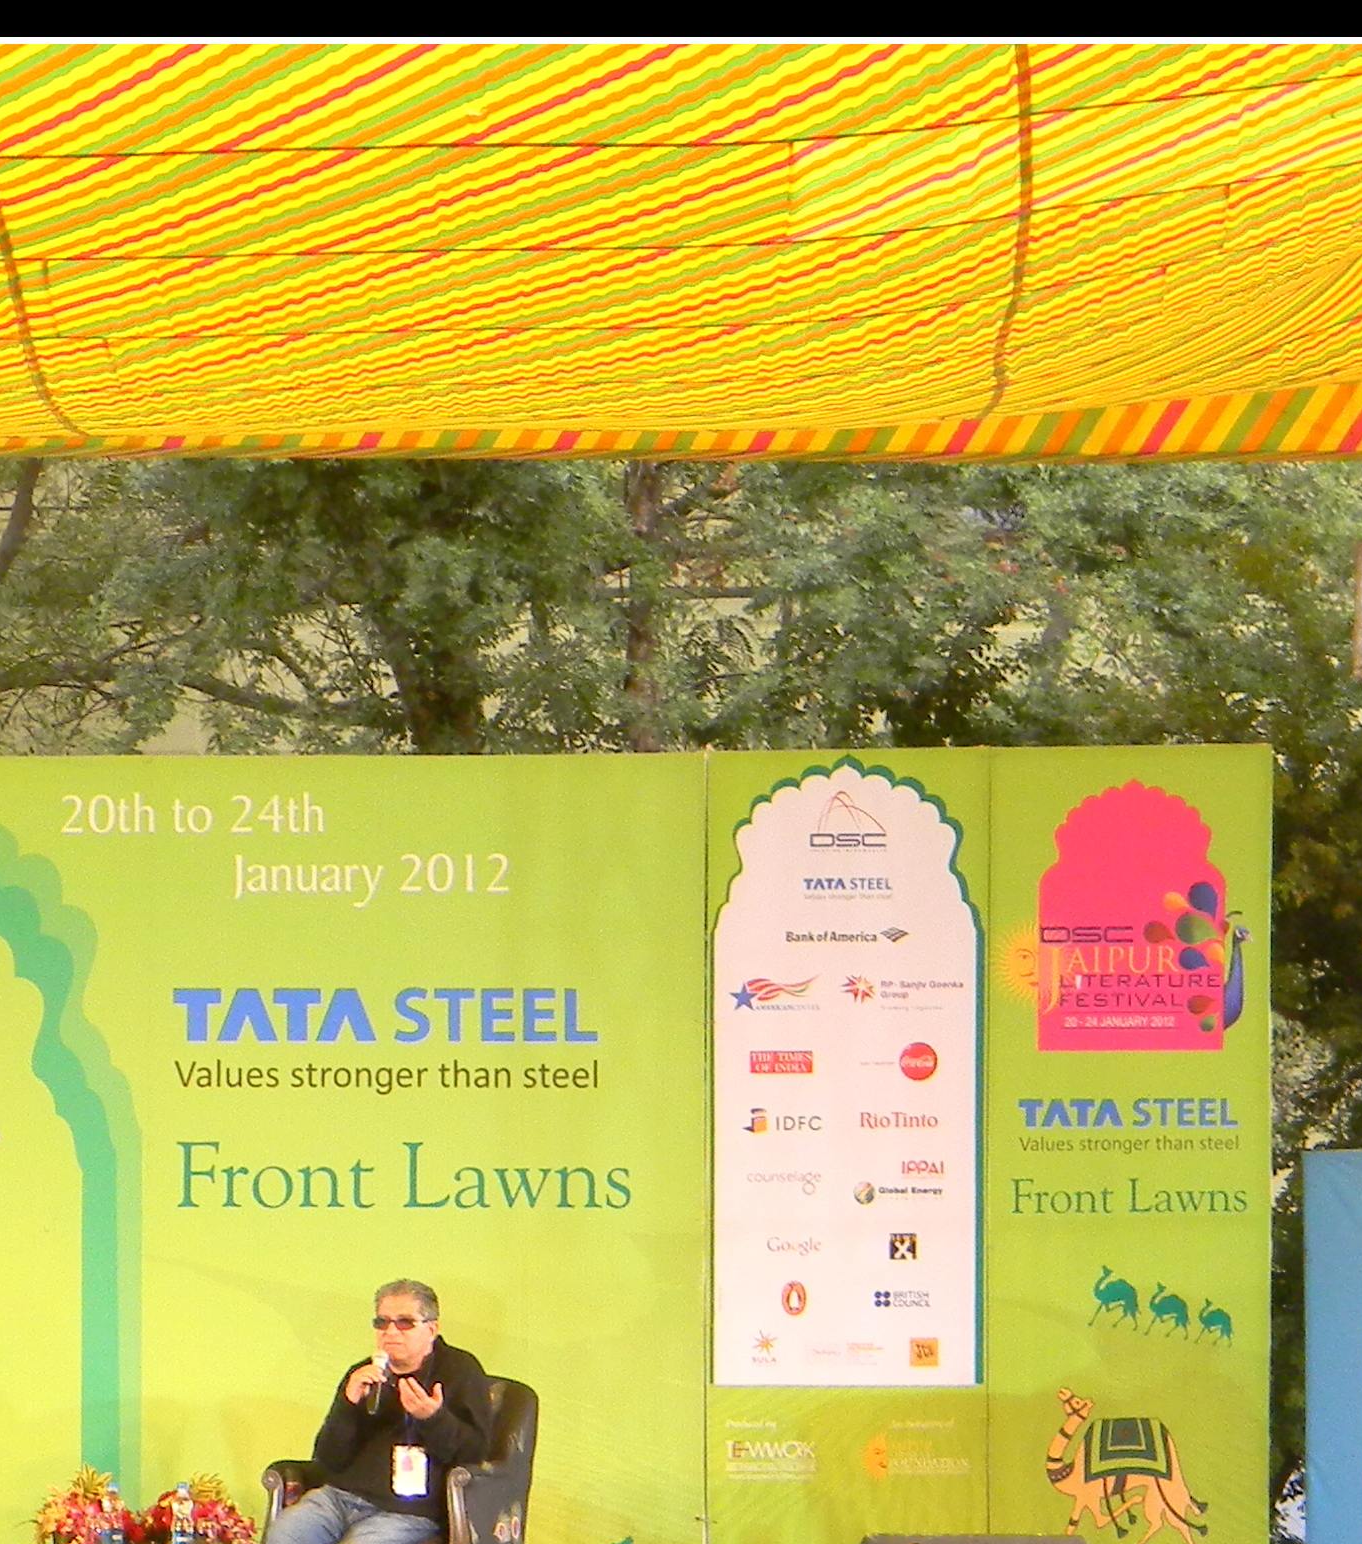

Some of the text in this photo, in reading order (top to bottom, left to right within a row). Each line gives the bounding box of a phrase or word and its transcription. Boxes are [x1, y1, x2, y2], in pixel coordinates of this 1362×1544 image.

[61, 793, 325, 834] 20th to 24th
[809, 833, 887, 848] DSC
[233, 853, 510, 909] January 2012
[803, 877, 893, 891] TATA STEEL
[785, 930, 878, 943] Bank of America
[1040, 926, 1134, 943] DSC
[1041, 945, 1179, 1016] JAIPUR
[1059, 974, 1222, 989] LITERATURE
[880, 991, 909, 1000] Group
[1059, 993, 1185, 1008] FESTIVAL
[173, 987, 600, 1044] TATA STEEL
[1064, 1016, 1077, 1027] 20
[1086, 1016, 1098, 1027] 24
[1100, 1016, 1148, 1028] JANUARY
[1150, 1016, 1175, 1027] 2012
[751, 1052, 812, 1062] THE TIMES
[755, 1063, 807, 1073] OF INDIA
[174, 1059, 600, 1095] Values stronger than steel
[1018, 1097, 1239, 1128] TATA STEEL
[775, 1115, 823, 1132] IDFC
[1019, 1135, 1239, 1154] Values stronger than steel
[176, 1140, 633, 1210] Front Lawns
[901, 1160, 944, 1175] IPPAI
[878, 1186, 943, 1197] Global Energy
[1011, 1177, 1249, 1214] Front Lawns
[766, 1236, 822, 1256] Google
[893, 1290, 930, 1299] BRITISH
[893, 1299, 931, 1307] COUNCIL
